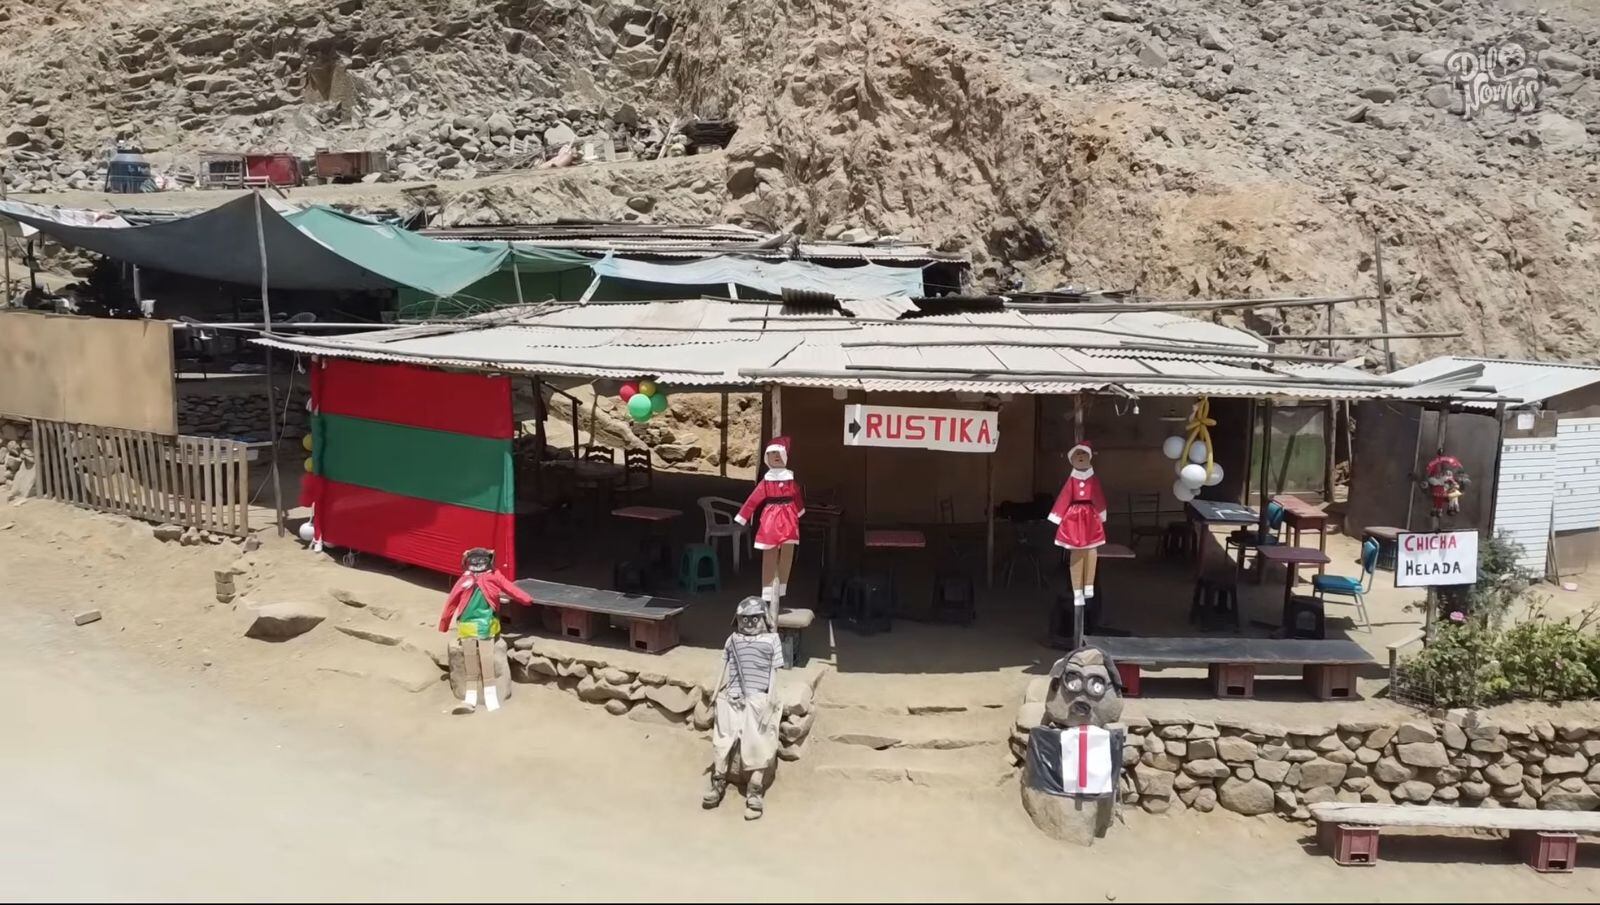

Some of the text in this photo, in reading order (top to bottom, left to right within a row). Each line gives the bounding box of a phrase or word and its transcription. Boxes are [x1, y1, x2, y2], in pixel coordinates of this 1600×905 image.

[866, 413, 991, 445] RUSTIKA
[1404, 534, 1457, 552] CHICHA
[1405, 560, 1461, 576] HELADA
